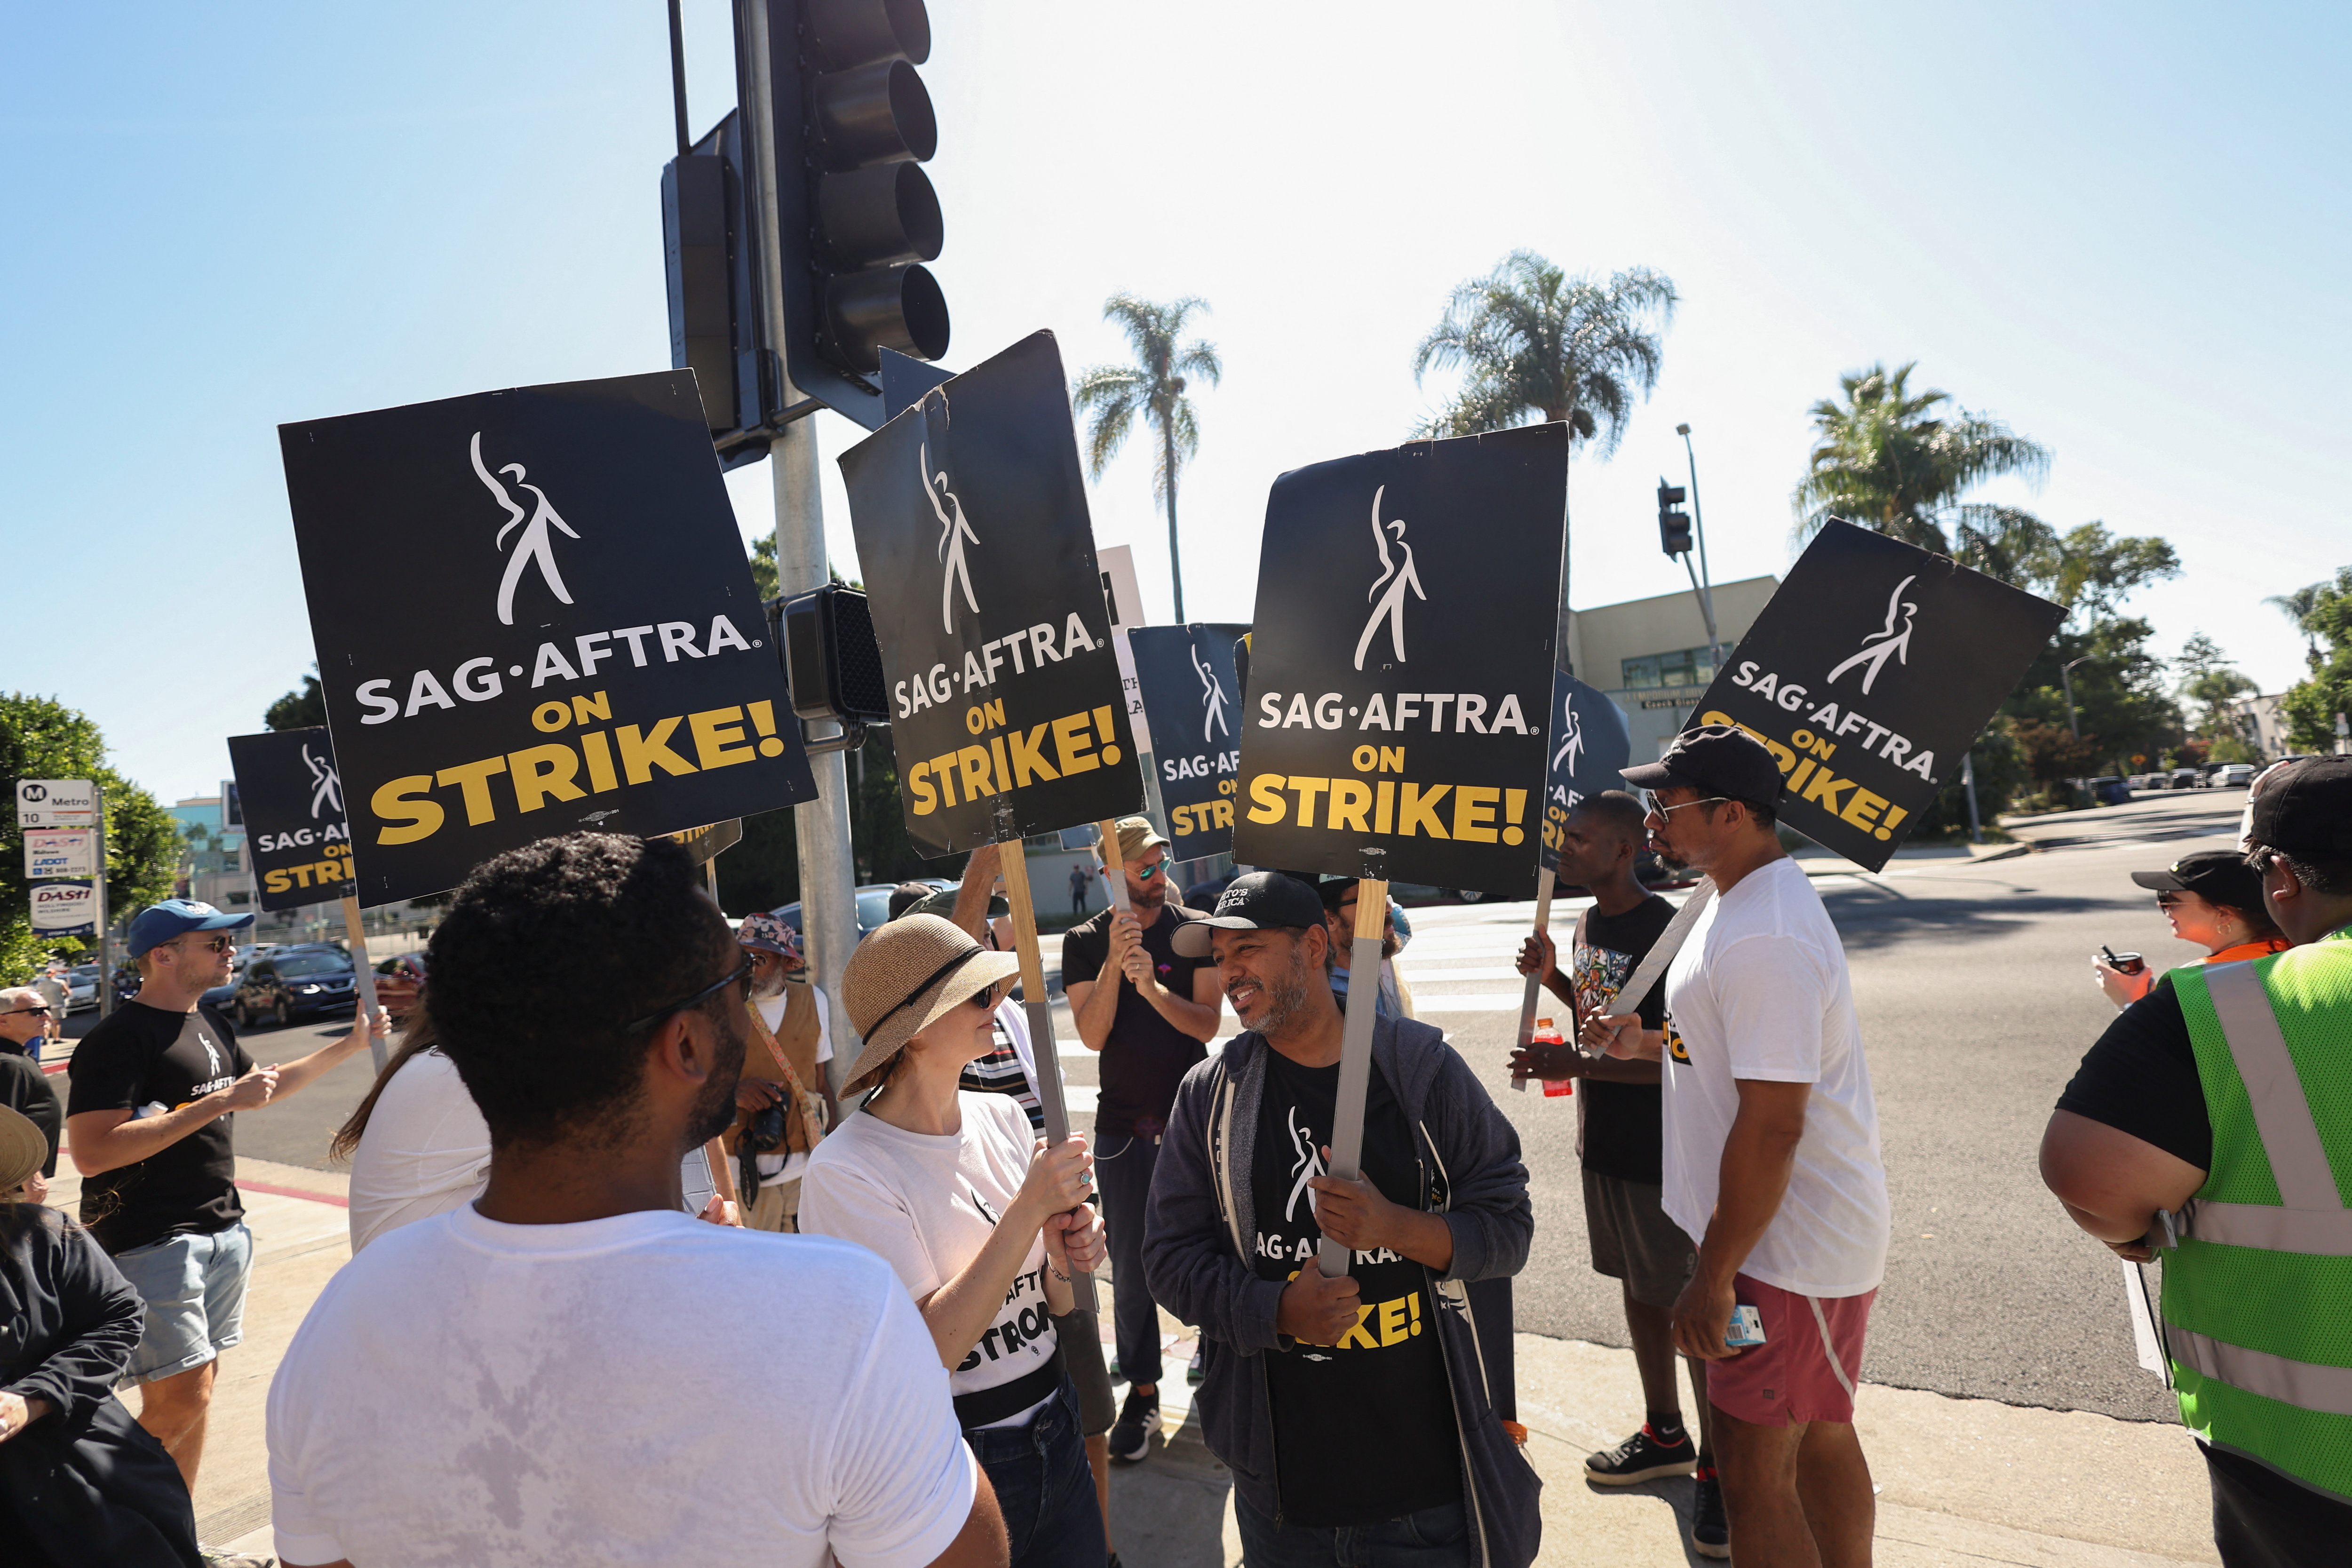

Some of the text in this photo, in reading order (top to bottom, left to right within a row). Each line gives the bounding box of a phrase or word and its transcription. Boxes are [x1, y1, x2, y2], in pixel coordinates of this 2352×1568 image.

[532, 691, 612, 732] ON
[966, 698, 1006, 735] ON
[1352, 744, 1405, 774] ON
[1791, 729, 1837, 757] ON
[371, 700, 784, 845] STRIKE!
[909, 705, 1121, 816] STRIKE!
[23, 813, 39, 823] 10
[1172, 797, 1236, 836] STR
[1246, 773, 1528, 846] STRIKE!
[323, 843, 352, 858] ON
[264, 857, 355, 893] STRI
[38, 889, 91, 902] DASH
[1216, 897, 1245, 910] ERICA
[1221, 888, 1248, 900] ITO'S
